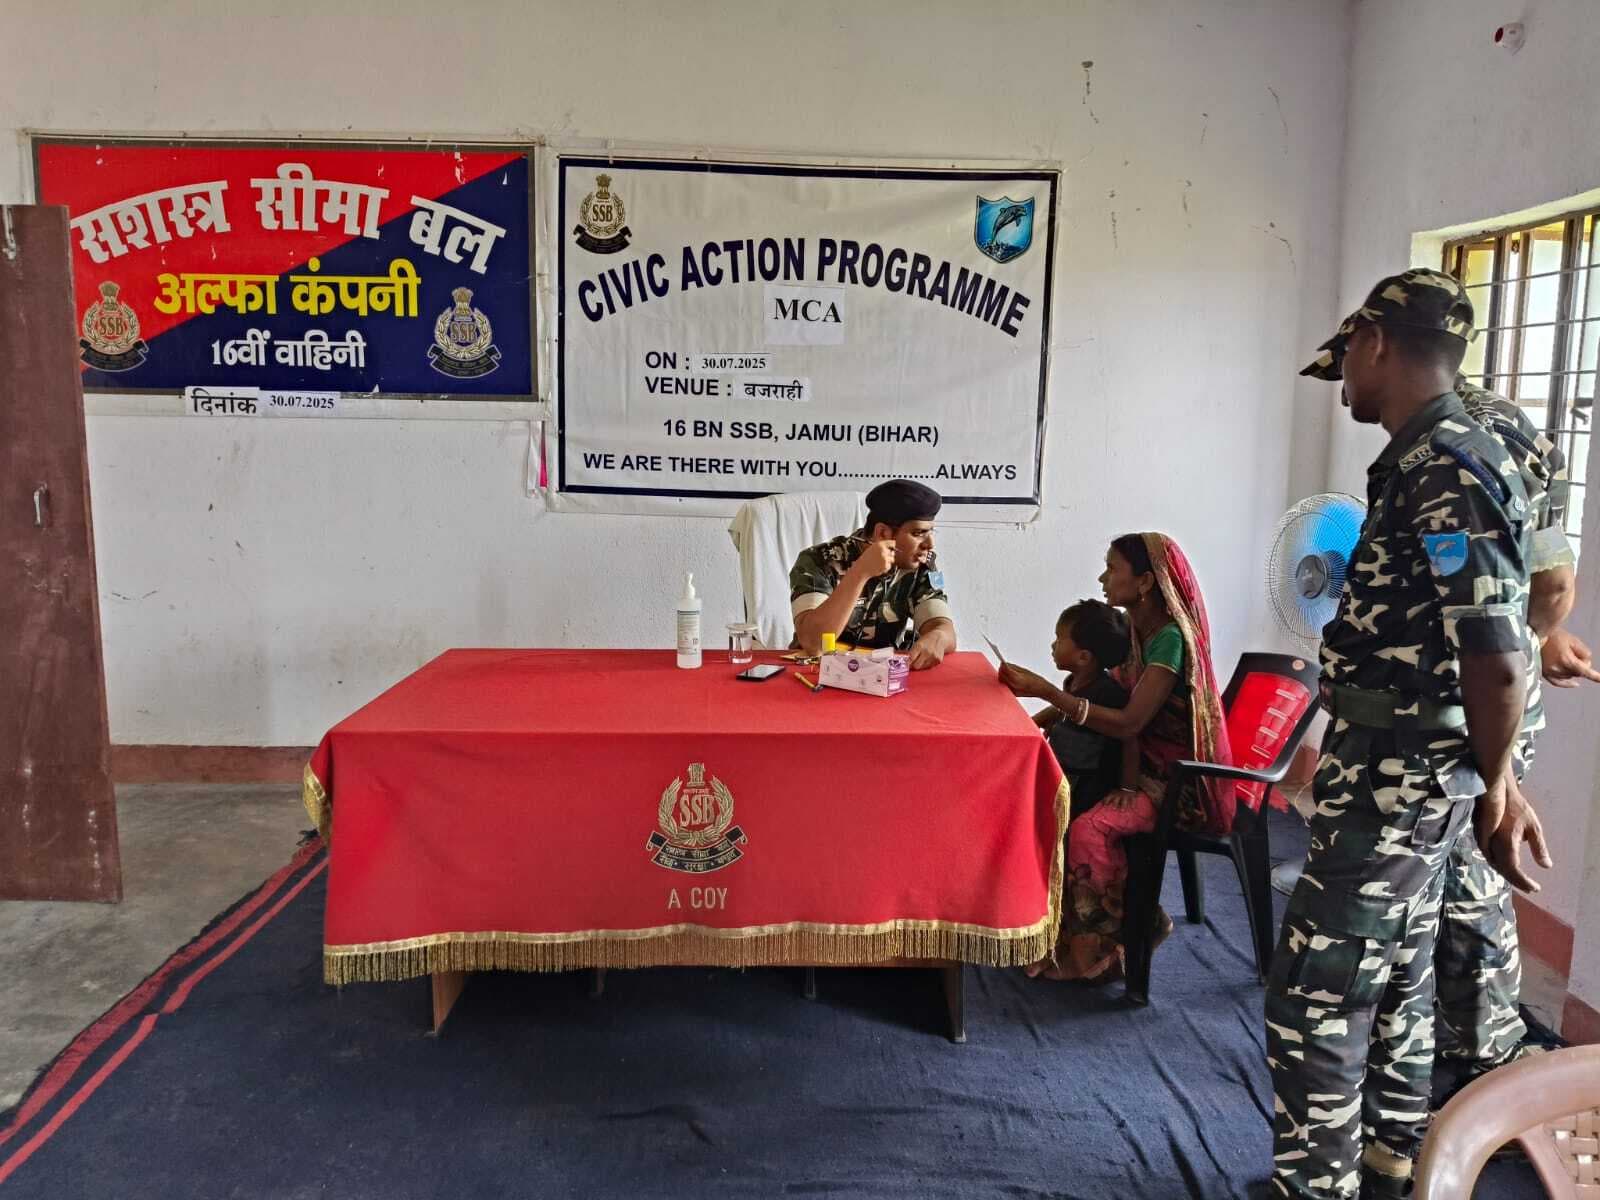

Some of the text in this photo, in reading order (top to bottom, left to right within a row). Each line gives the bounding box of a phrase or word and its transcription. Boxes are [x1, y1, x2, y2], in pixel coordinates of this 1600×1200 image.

[70, 163, 507, 274] सशस्त्र सीमा बल
[592, 204, 613, 222] SSB
[154, 257, 421, 317] अल्फा कंपनी
[578, 237, 1031, 338] CIVIC ACTION PROGRAMME
[774, 298, 842, 323] MCA
[99, 316, 123, 336] SSB
[212, 328, 367, 370] 16वीं वाहिनी
[645, 351, 677, 370] ON
[701, 357, 766, 369] 30.07.2025
[645, 376, 719, 396] VENUE
[744, 380, 803, 400] बजराही
[190, 388, 335, 414] दिनांक 30.07.2025
[663, 419, 939, 447] 16 BN SSB, JAMUI (BIHAR)
[583, 453, 615, 469] WE
[620, 455, 662, 471] ARE
[668, 457, 734, 474] THERE
[740, 459, 790, 476] WITH
[679, 794, 716, 827] SSB
[668, 887, 728, 910] A COY
